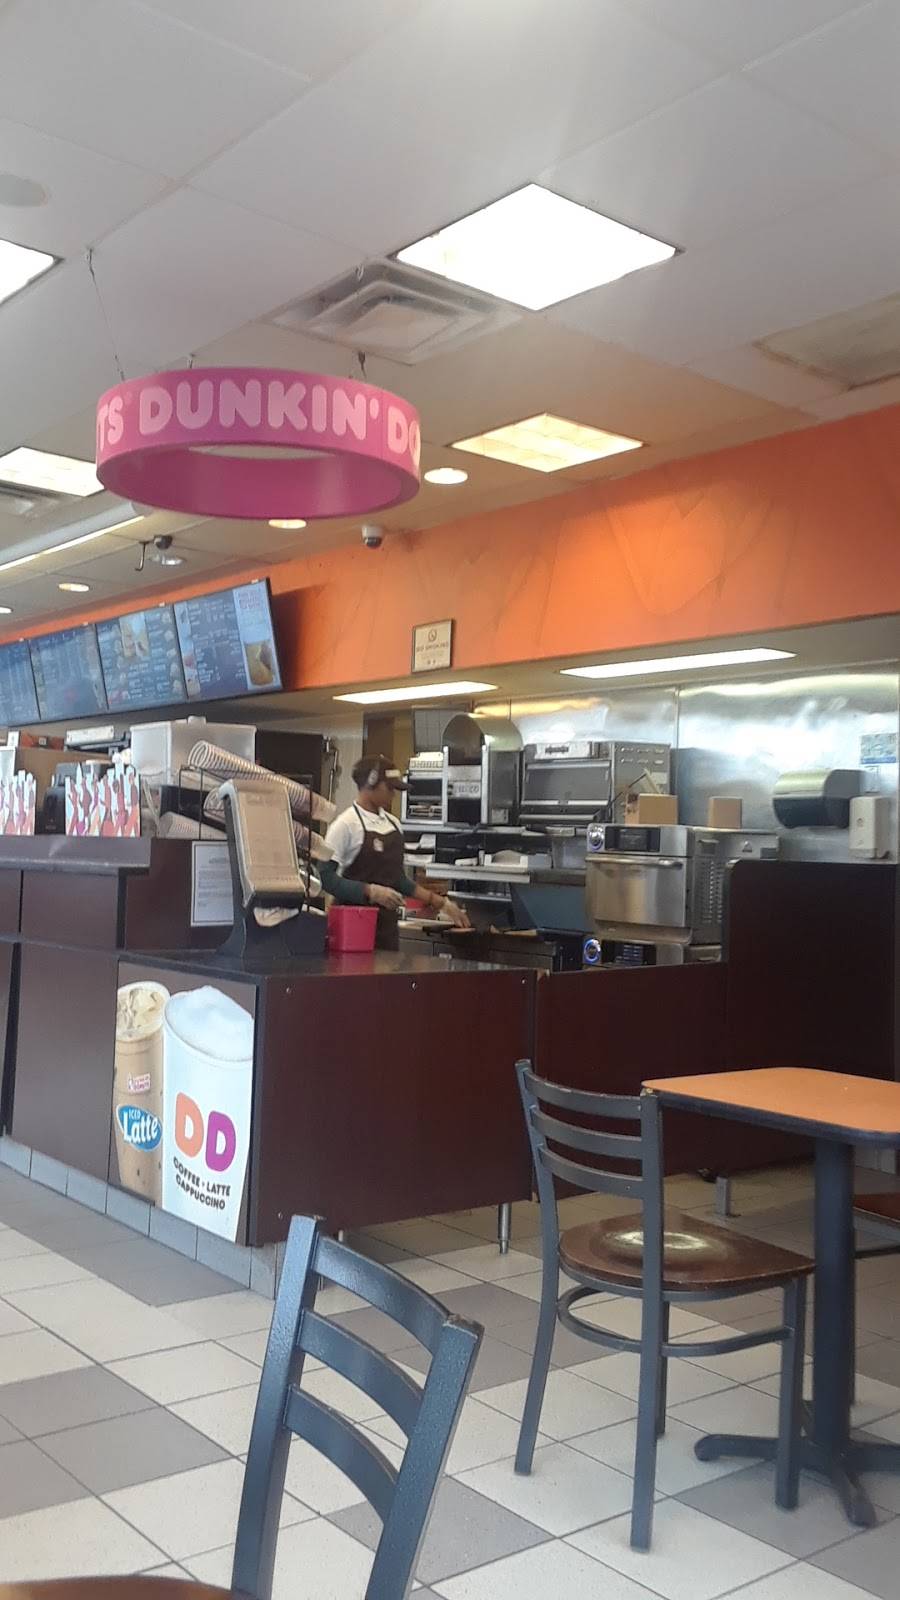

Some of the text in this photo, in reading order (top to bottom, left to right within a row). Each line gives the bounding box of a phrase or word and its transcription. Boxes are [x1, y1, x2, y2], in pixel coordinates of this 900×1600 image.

[139, 379, 379, 440] DUNKIN'
[123, 1111, 158, 1143] Latte
[128, 1108, 141, 1120] ICED
[173, 1156, 231, 1197] COFFEE LATTE
[175, 1173, 226, 1211] CAPPUCCINO
